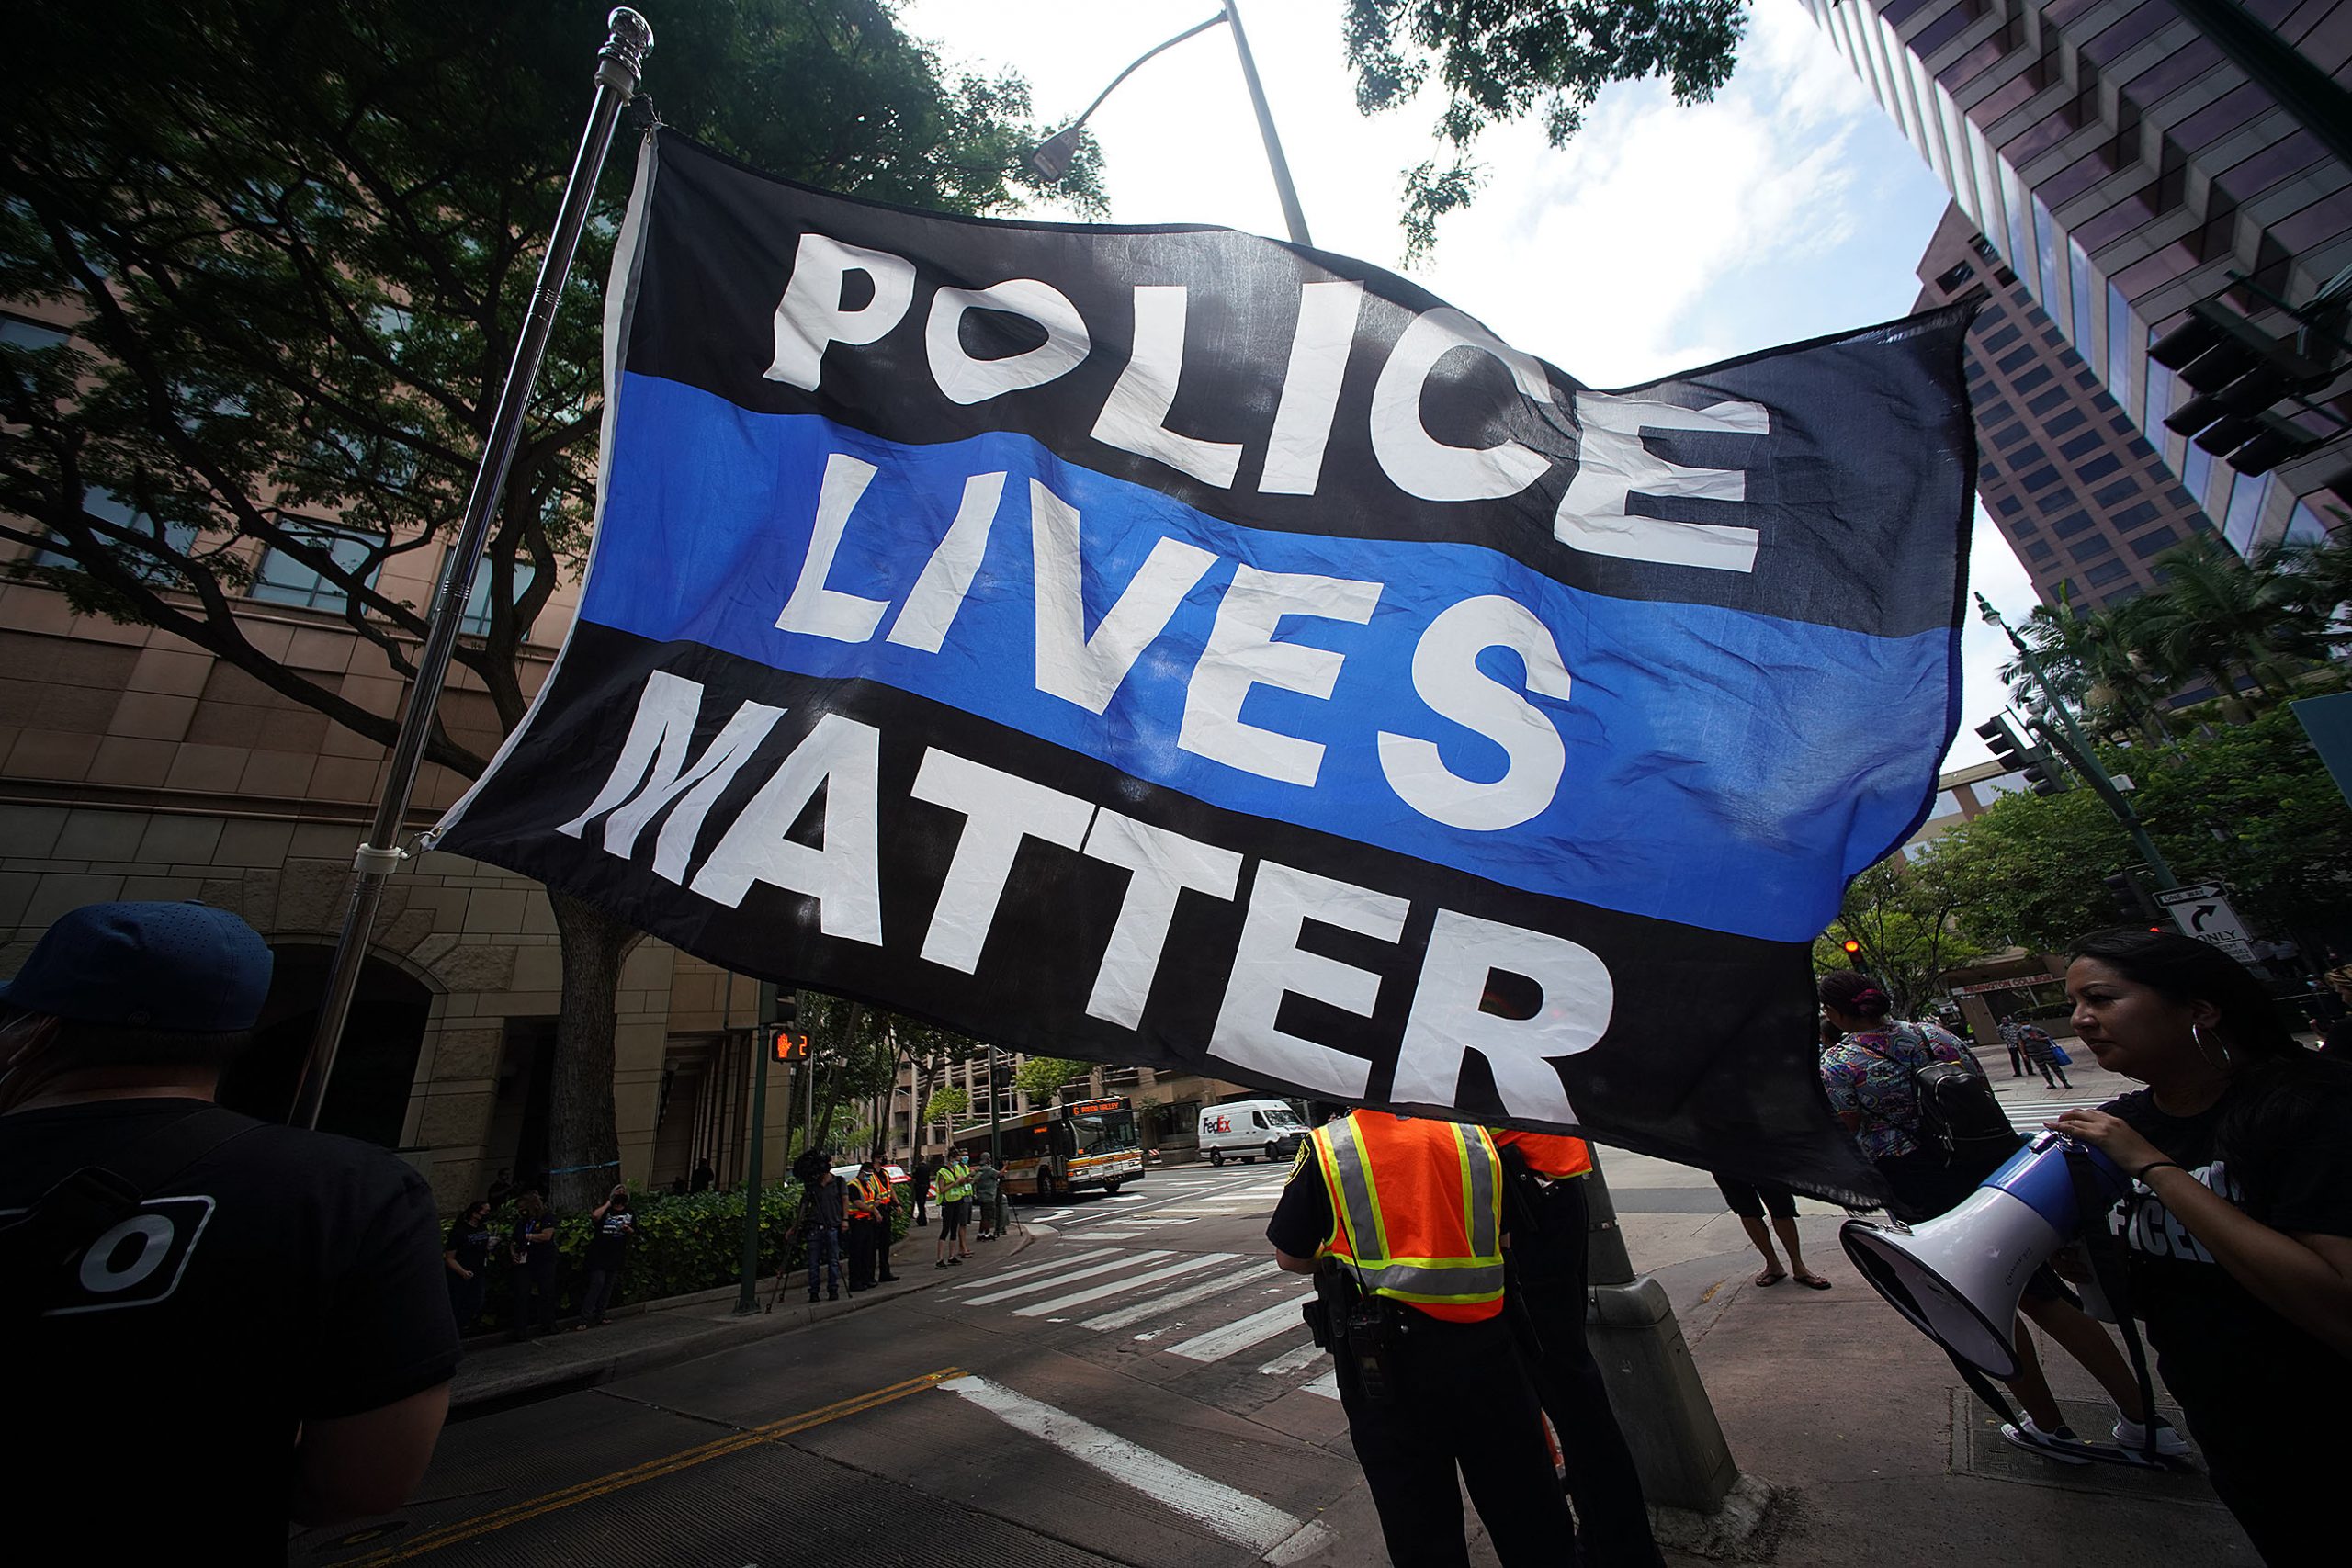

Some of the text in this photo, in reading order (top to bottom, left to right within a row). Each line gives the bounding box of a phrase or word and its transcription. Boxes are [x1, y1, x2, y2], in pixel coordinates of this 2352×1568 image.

[763, 233, 1770, 573] POLICE
[775, 453, 1571, 831] LIVES
[555, 670, 1614, 1125] MATTER
[2164, 888, 2204, 902] ONE WAY
[2012, 974, 2052, 987] COLLEGE
[799, 1035, 808, 1055] 2
[1203, 1115, 1232, 1134] FedEx
